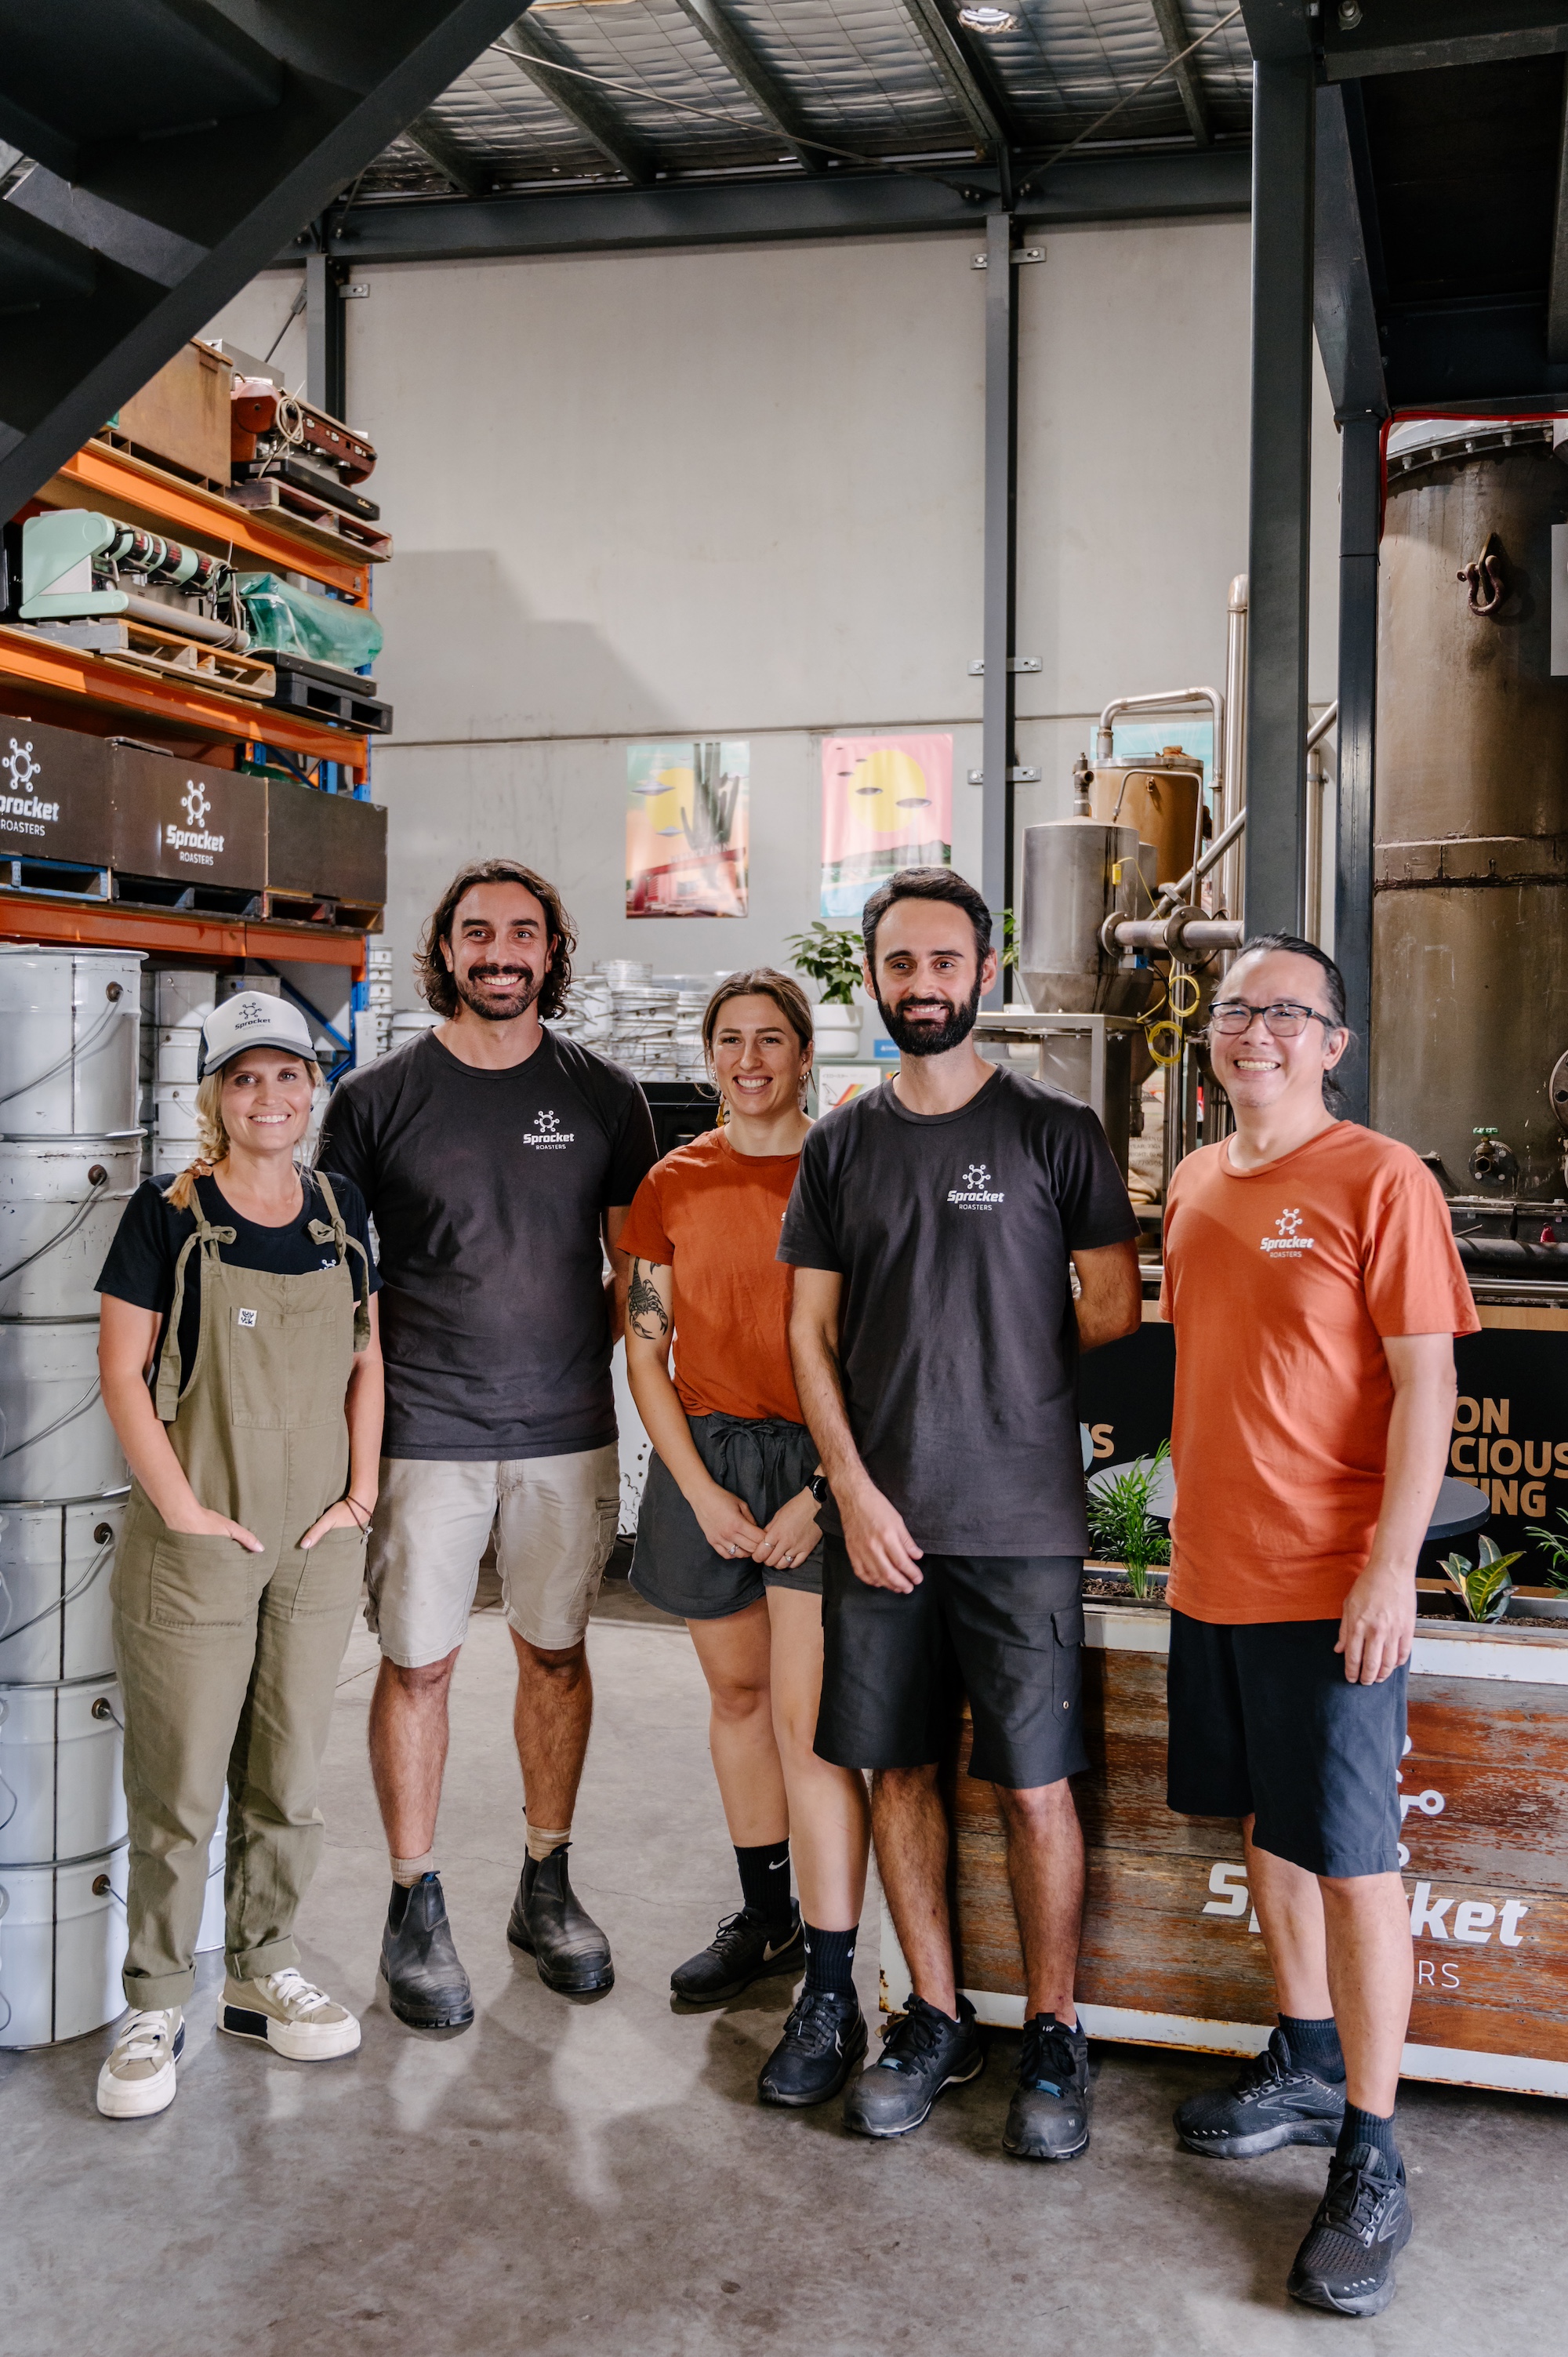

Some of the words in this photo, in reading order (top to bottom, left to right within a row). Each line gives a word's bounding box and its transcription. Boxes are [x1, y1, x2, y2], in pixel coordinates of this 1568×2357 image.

[1, 819, 45, 837] ROASTERS
[165, 824, 224, 852] Sprocket
[180, 852, 214, 866] ROASTERS
[235, 1019, 270, 1030] Sprocket
[523, 1132, 575, 1145] Sprocket
[947, 1190, 1004, 1204] Sprocket
[1260, 1236, 1314, 1251] Sprocket
